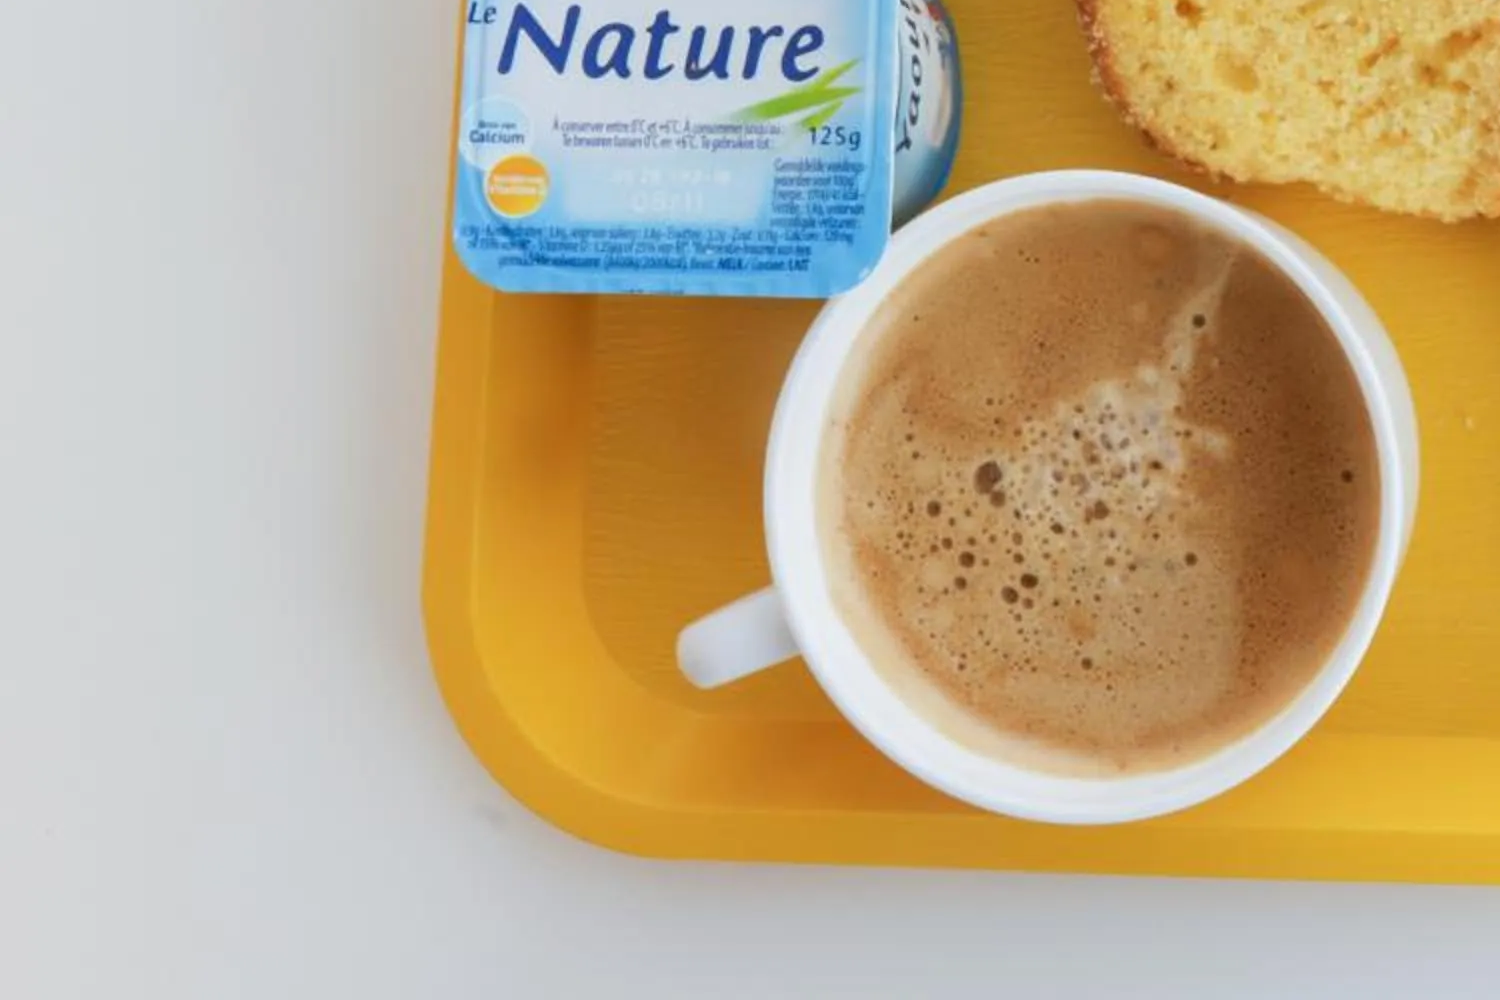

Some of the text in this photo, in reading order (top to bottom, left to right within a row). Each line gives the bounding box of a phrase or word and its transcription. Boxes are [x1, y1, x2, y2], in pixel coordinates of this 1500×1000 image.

[468, 0, 824, 81] Le Nature
[469, 129, 525, 144] Calcium
[808, 125, 861, 151] 125g
